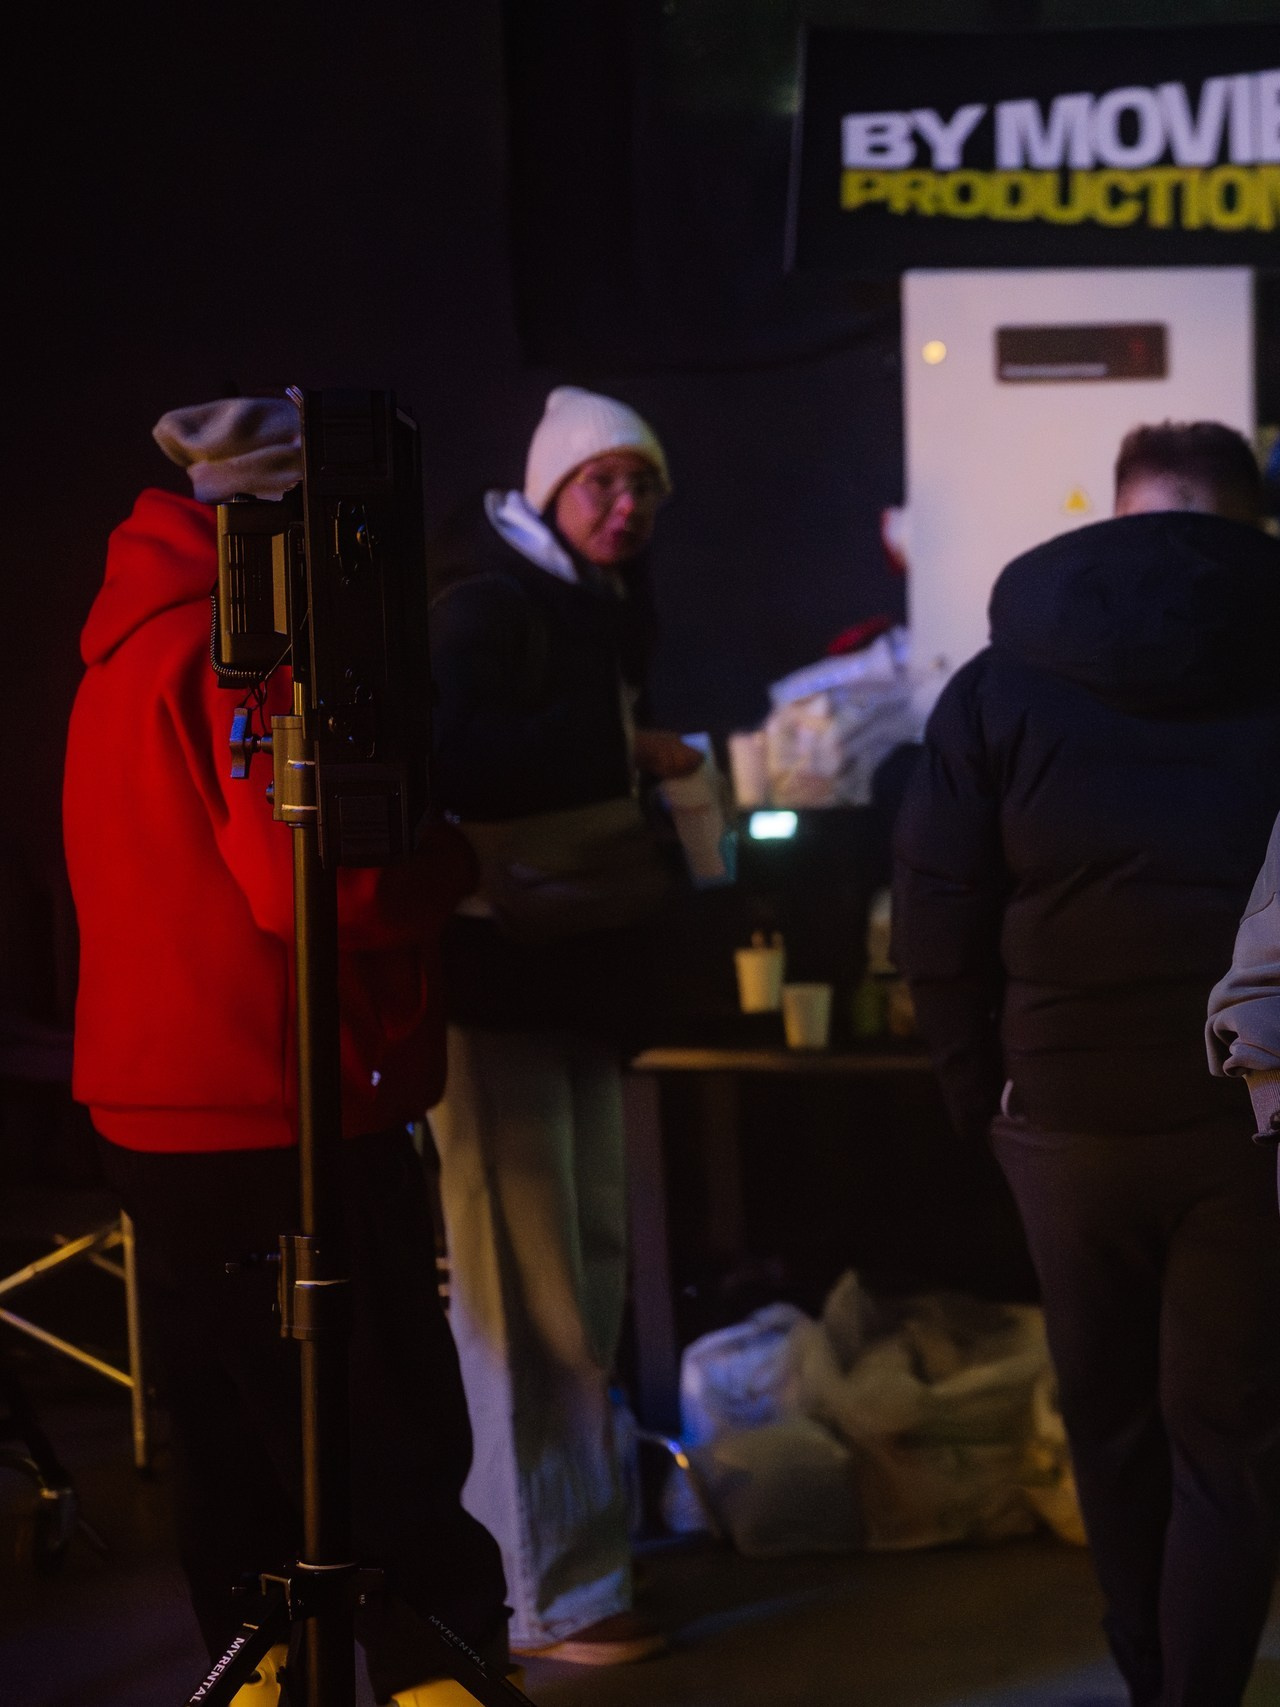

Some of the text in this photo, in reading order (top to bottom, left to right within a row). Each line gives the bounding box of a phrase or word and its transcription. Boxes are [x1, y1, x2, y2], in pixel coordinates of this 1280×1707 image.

[841, 103, 987, 170] BY
[189, 1637, 246, 1703] MYRENTAL
[428, 1615, 487, 1670] MYRENTAL
